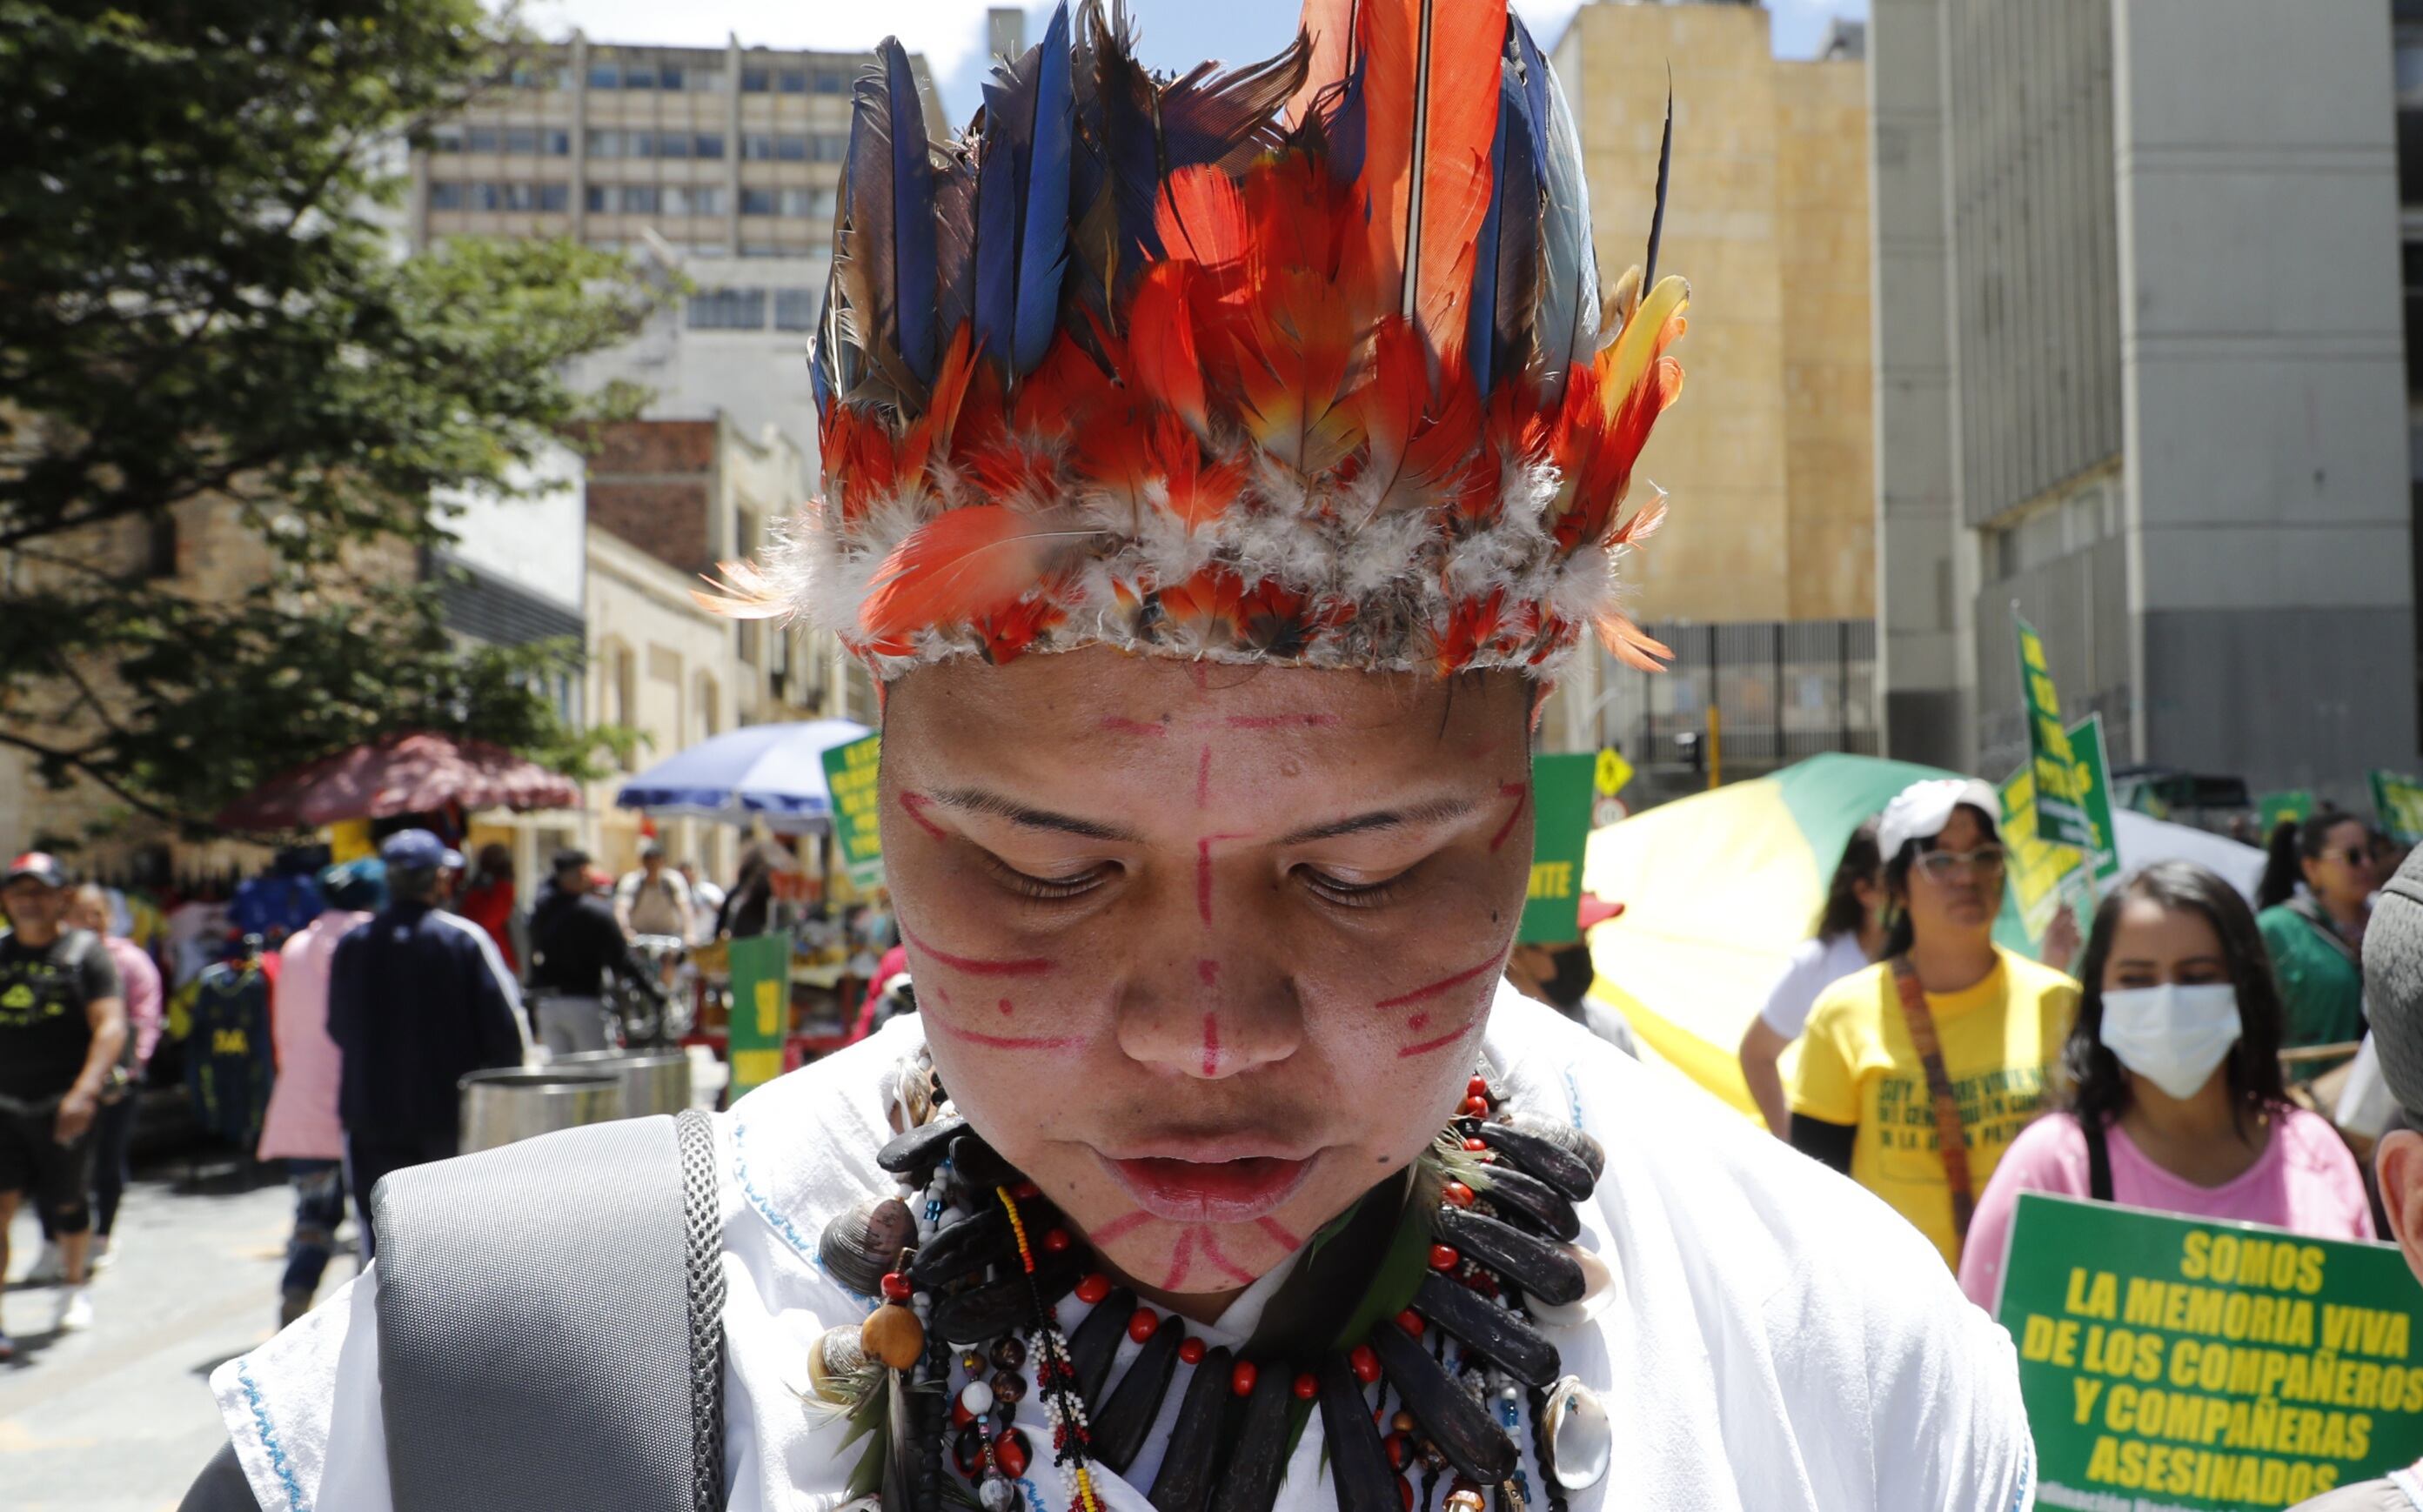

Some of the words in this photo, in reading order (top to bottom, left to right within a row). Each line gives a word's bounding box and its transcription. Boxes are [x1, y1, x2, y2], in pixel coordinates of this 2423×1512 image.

[2180, 1229, 2326, 1295] SOMOS
[2065, 1267, 2118, 1320] LA
[2124, 1276, 2314, 1348] MEMORIA
[2322, 1303, 2410, 1359] VIVA
[2021, 1313, 2079, 1367] DE
[2083, 1325, 2164, 1382] LOS
[2168, 1339, 2423, 1414] COMPAÑEROS
[2073, 1376, 2103, 1425] Y
[2105, 1383, 2373, 1461] COMPAÑERAS
